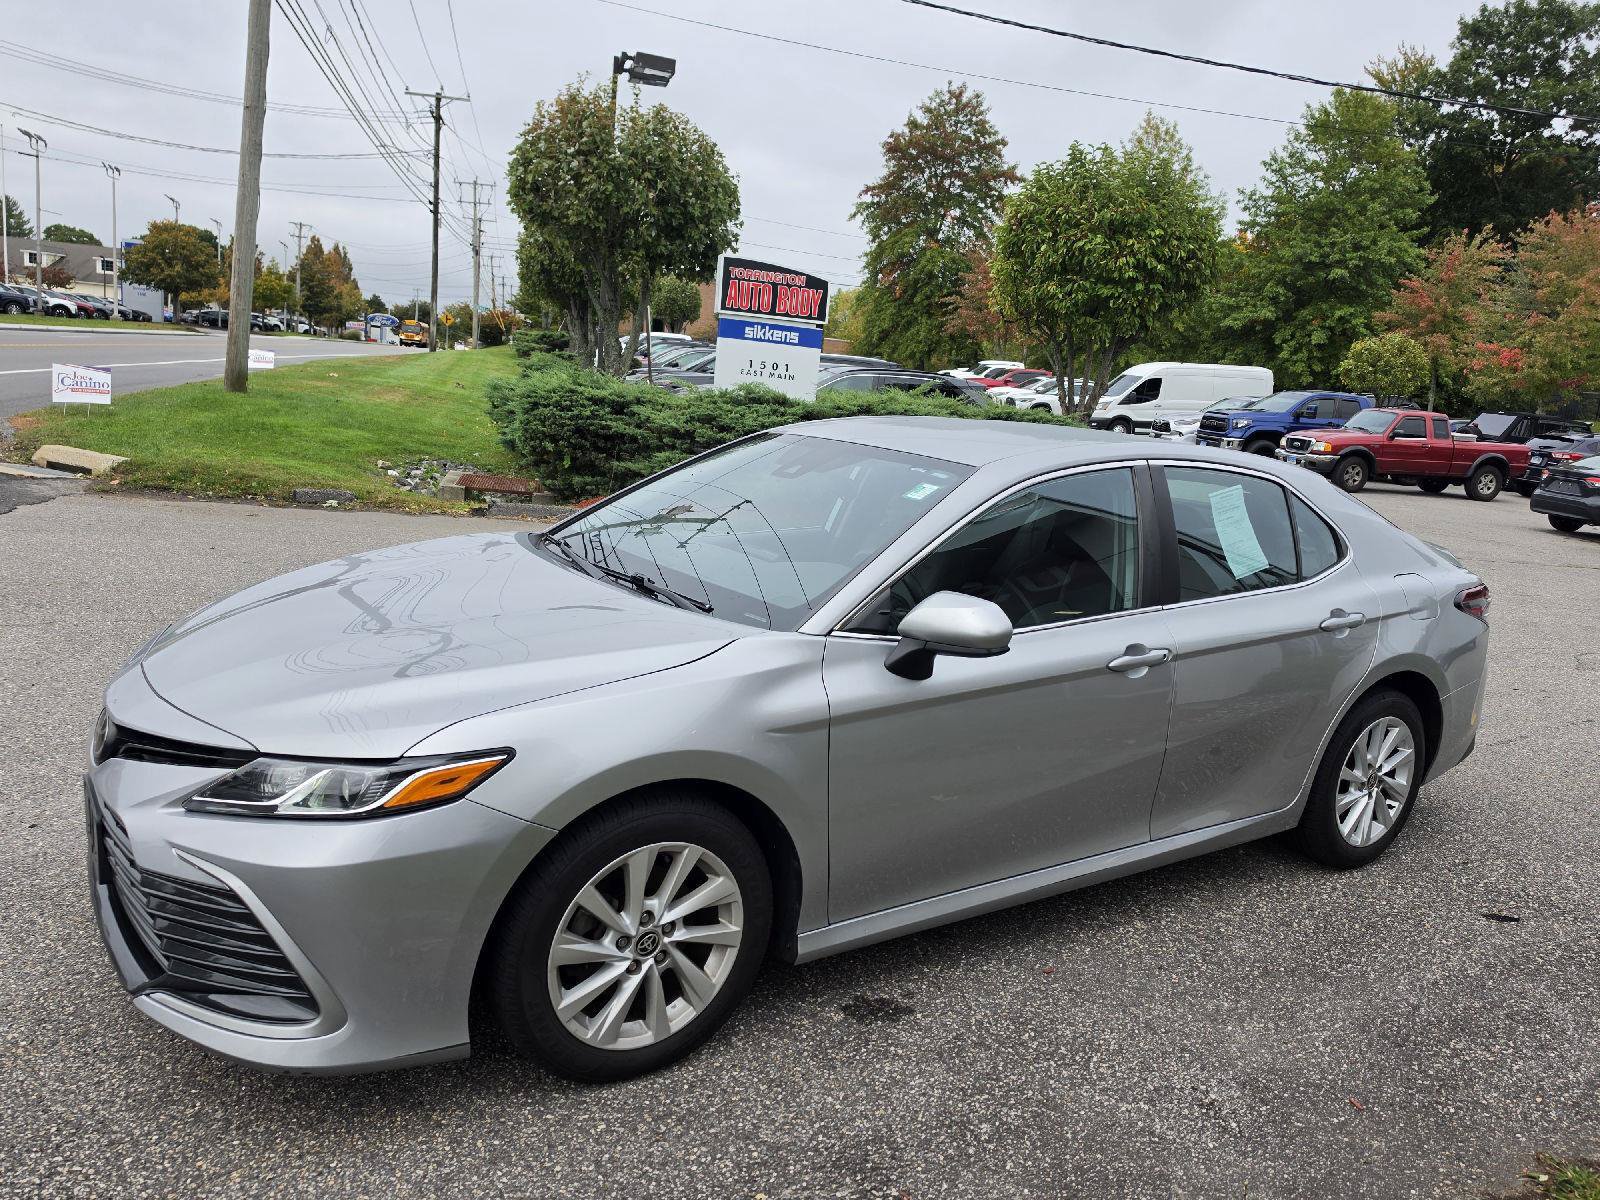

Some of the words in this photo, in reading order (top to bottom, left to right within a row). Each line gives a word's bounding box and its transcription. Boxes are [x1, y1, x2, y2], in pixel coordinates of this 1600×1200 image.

[729, 267, 807, 286] TORRINGTON
[726, 279, 773, 312] AUTO
[776, 285, 824, 318] BODY
[744, 325, 800, 344] sikkens
[749, 359, 789, 372] 1501
[72, 371, 88, 381] Joe
[740, 368, 763, 377] EAST
[768, 371, 795, 381] MAIN
[61, 376, 110, 389] Canino
